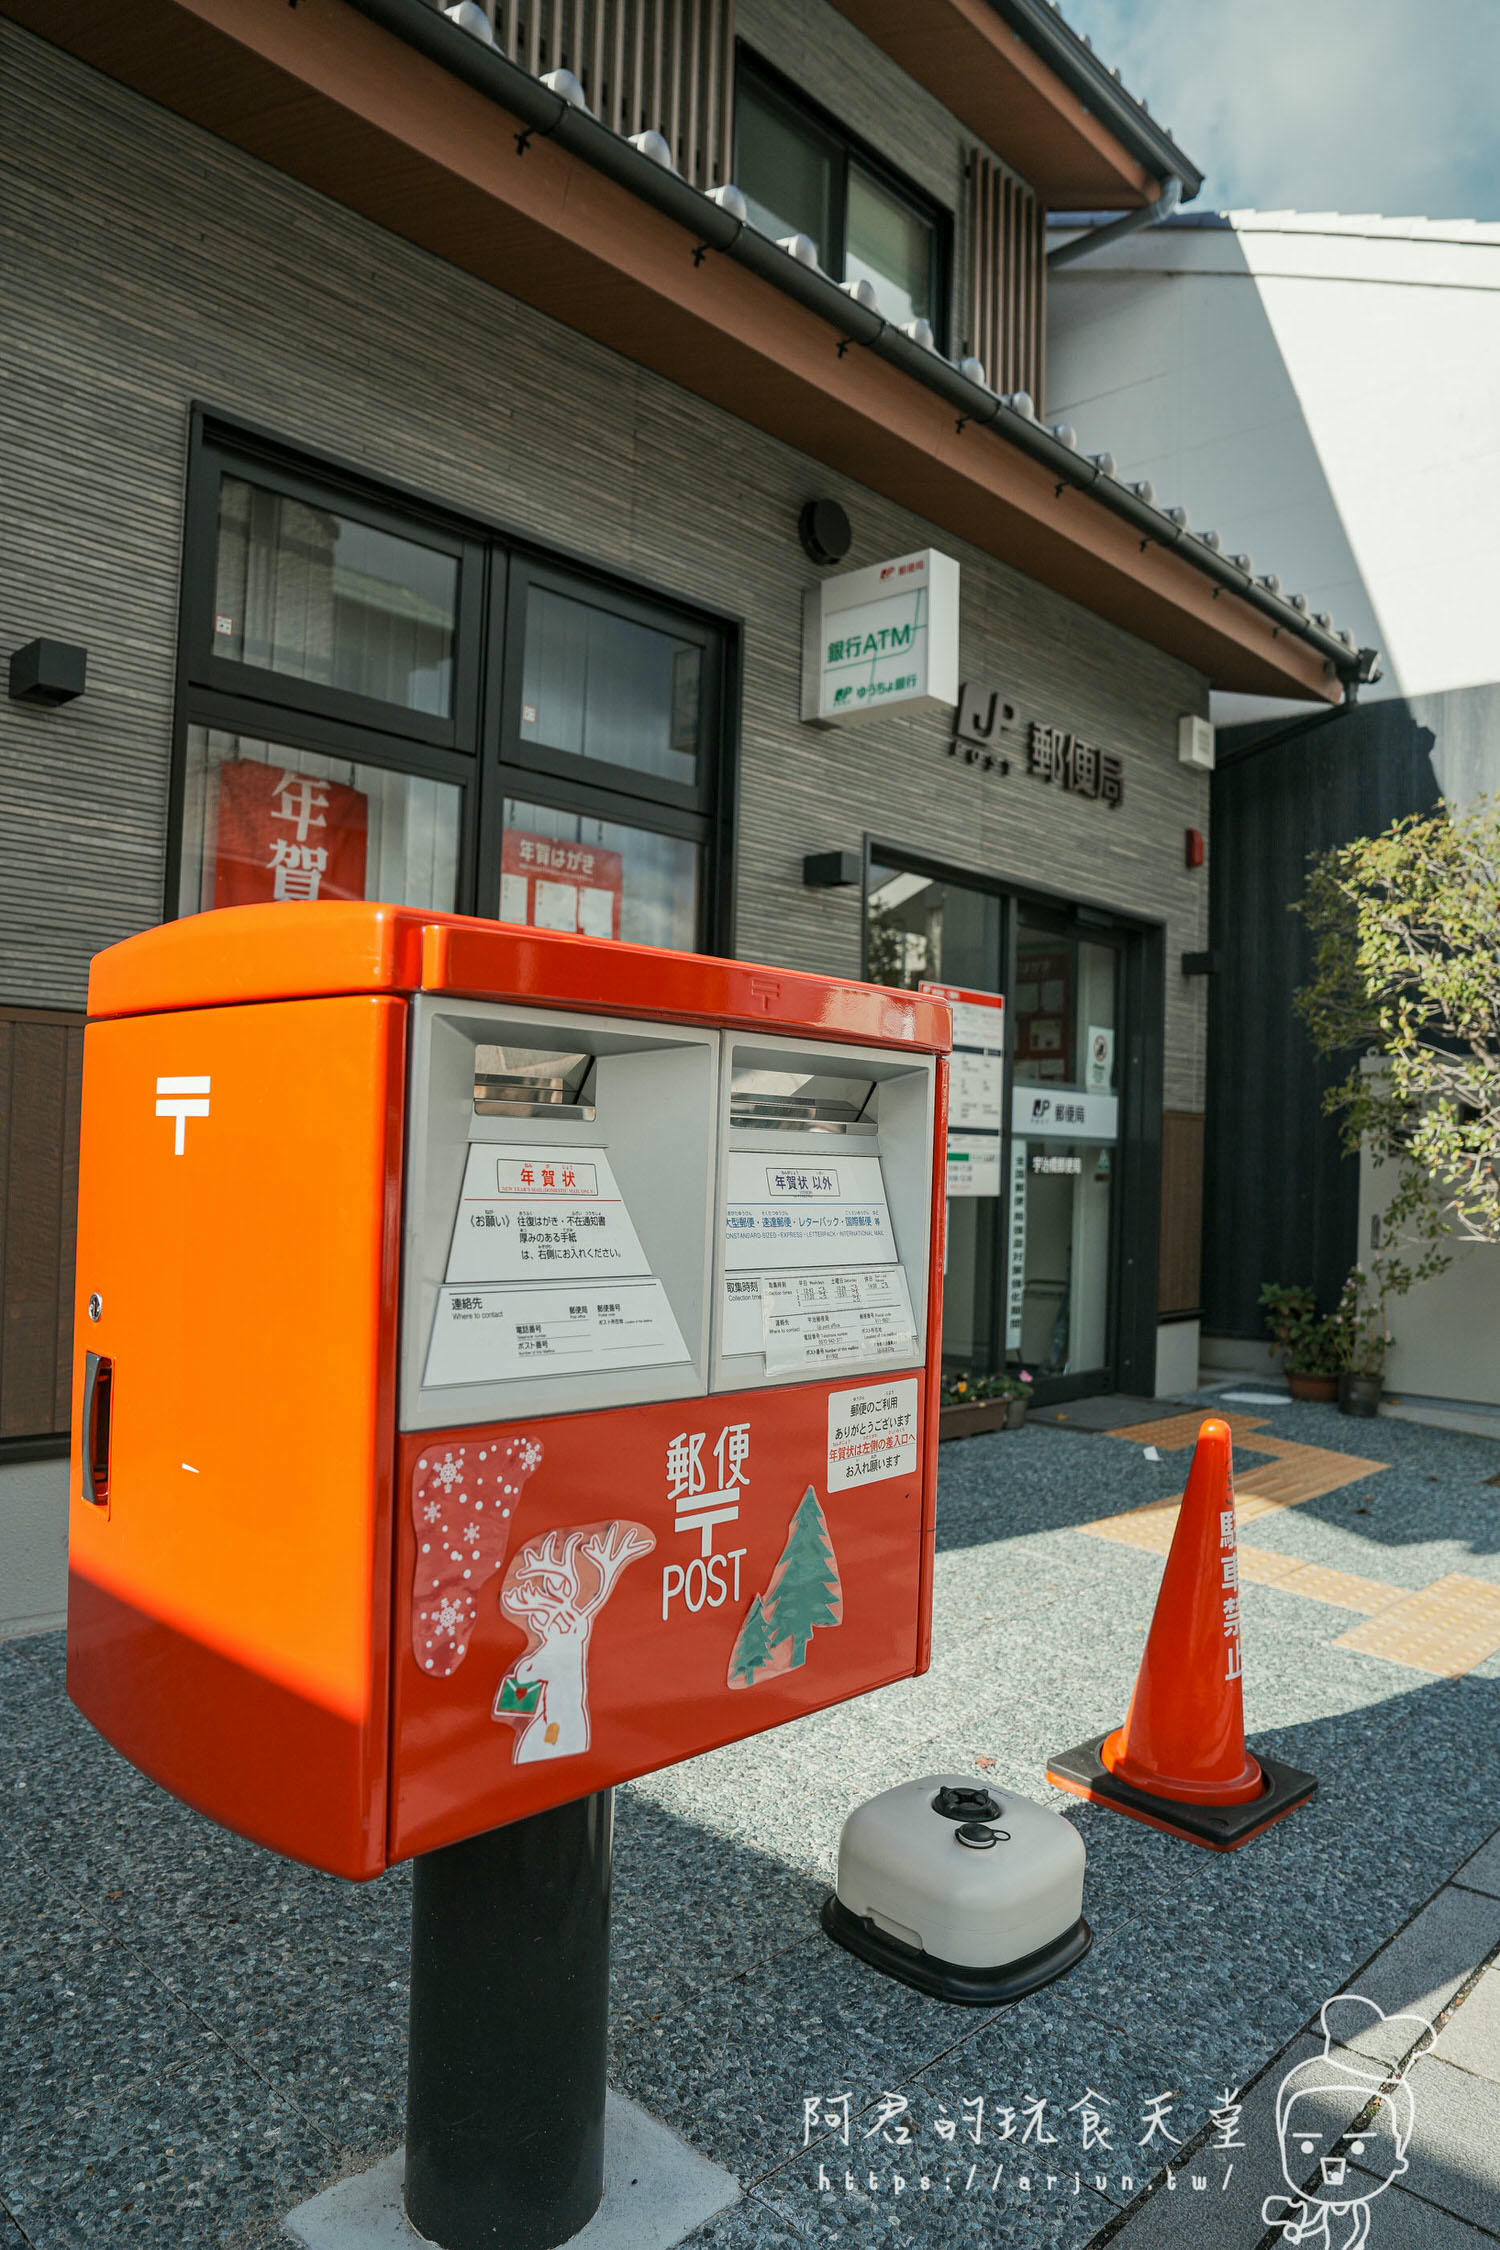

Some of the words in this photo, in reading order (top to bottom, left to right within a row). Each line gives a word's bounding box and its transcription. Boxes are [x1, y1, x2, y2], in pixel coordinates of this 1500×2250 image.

[827, 623, 912, 664] 銀行ATM
[857, 674, 917, 698] ゆうちょ銀行
[1029, 720, 1123, 808] 郵便局
[266, 770, 332, 900] 年賀
[519, 839, 595, 875] 年賀はがき
[520, 1168, 577, 1188] 年賀状
[775, 1175, 809, 1190] 年賀状
[813, 1175, 833, 1190] 以外
[517, 1216, 606, 1227] 往復はがき・不在通知書
[519, 1232, 578, 1244] 厚みのある手紙
[521, 1249, 622, 1260] は、右側にお入れください。
[726, 1281, 759, 1293] 取集時刻
[452, 1297, 484, 1311] 連絡先
[728, 1294, 751, 1302] Collection
[453, 1312, 473, 1320] Where
[482, 1311, 503, 1319] contact
[515, 1324, 542, 1335] 電話番号
[518, 1340, 549, 1350] ポスト番号
[850, 1396, 898, 1418] 郵便のご利用
[835, 1413, 912, 1440] ありがとうございます
[829, 1433, 917, 1462] 年賀状は左側の差入口へ
[666, 1422, 751, 1500] 郵便
[845, 1454, 901, 1478] お入れ願います
[662, 1548, 747, 1621] POST
